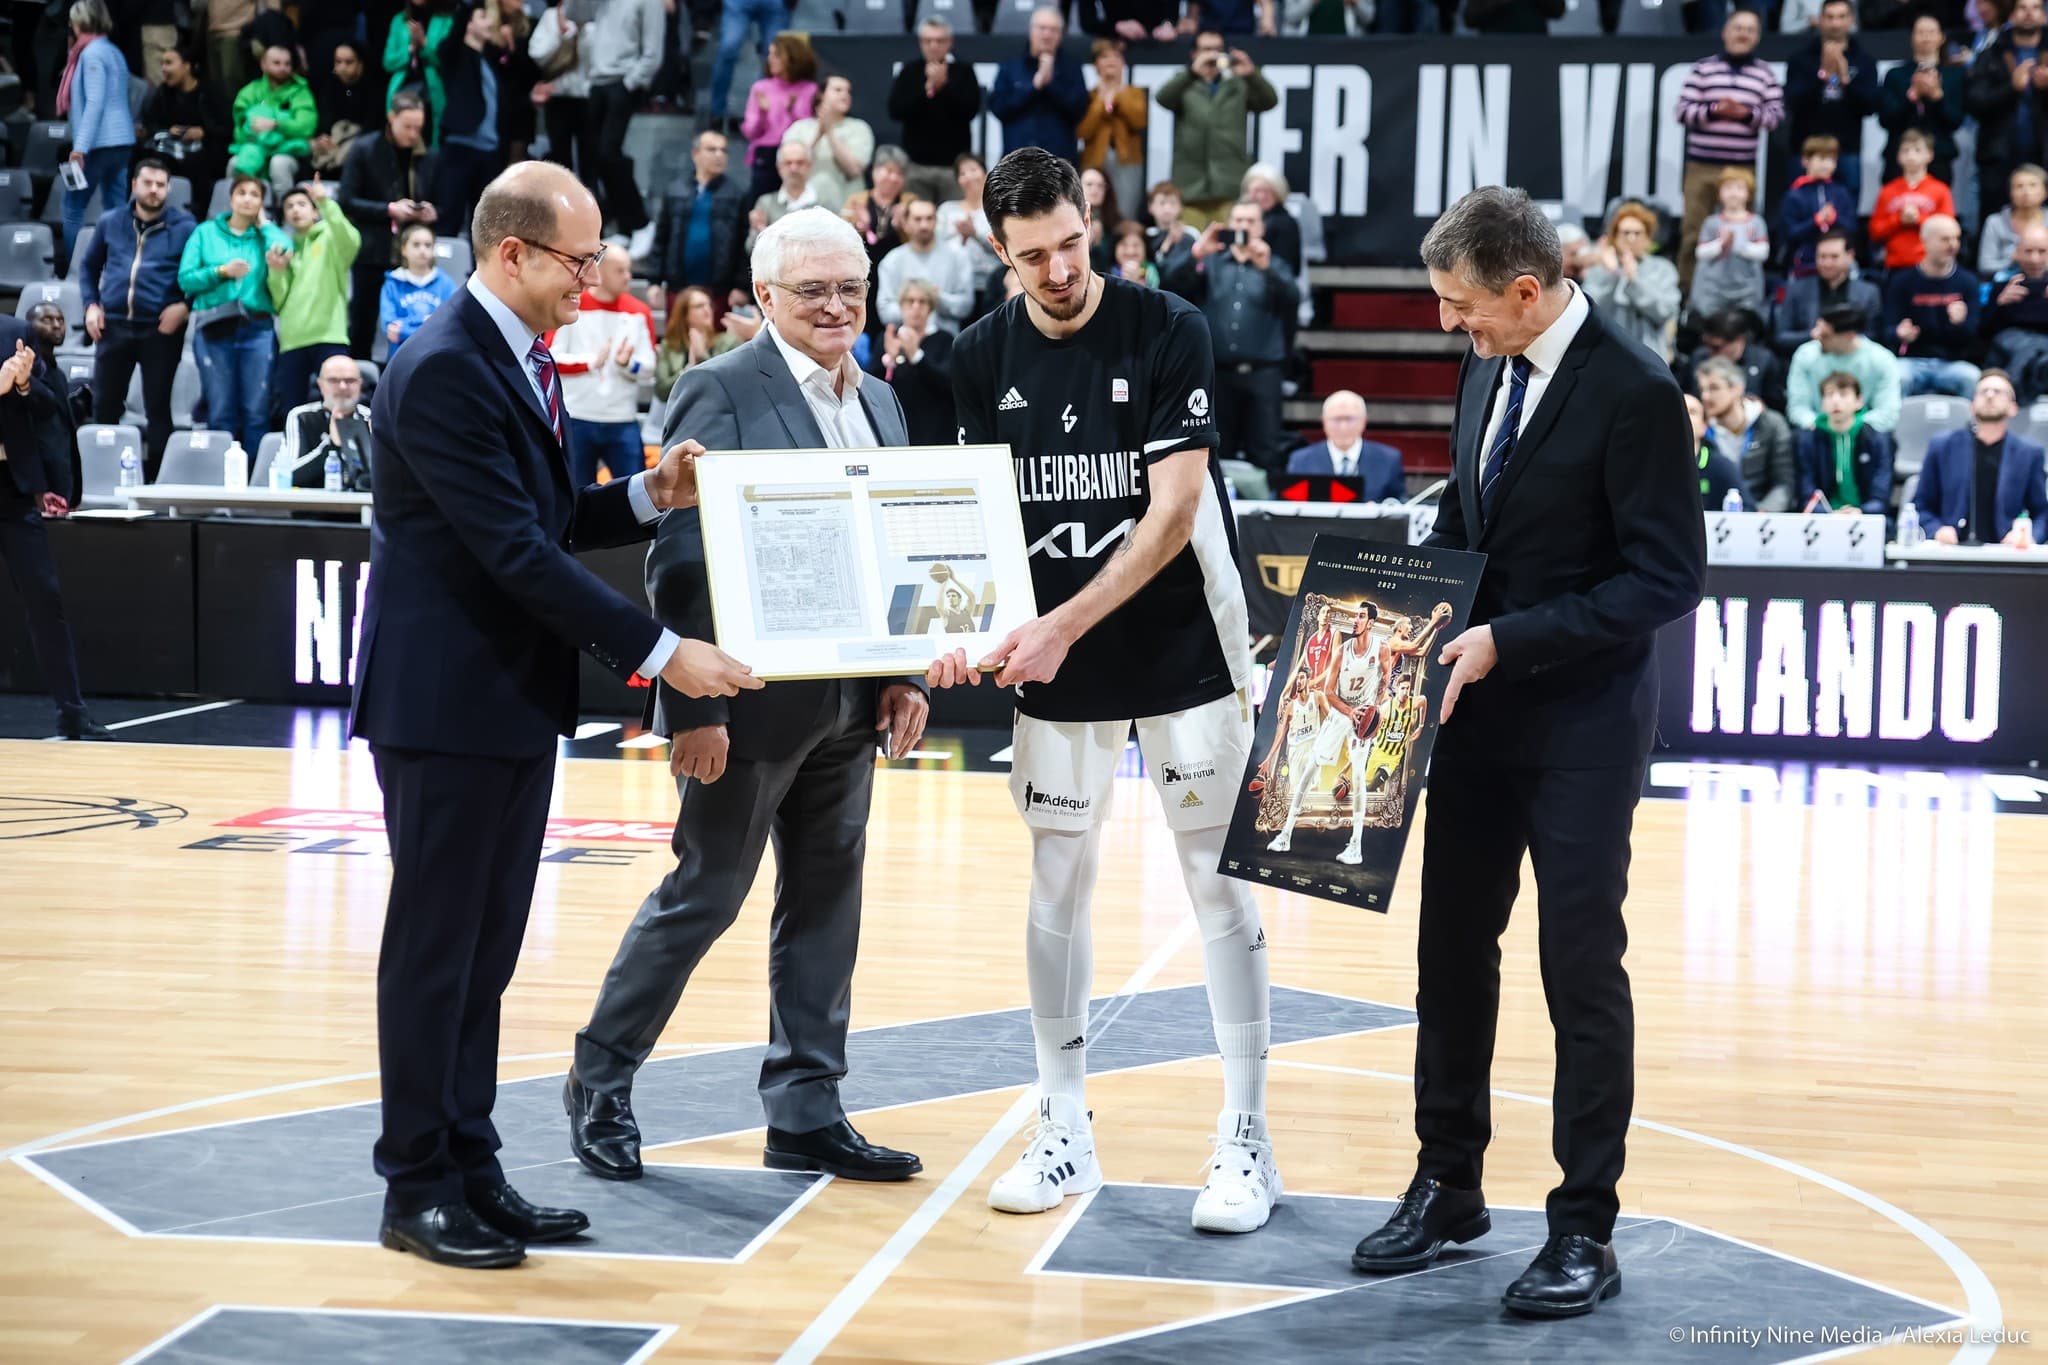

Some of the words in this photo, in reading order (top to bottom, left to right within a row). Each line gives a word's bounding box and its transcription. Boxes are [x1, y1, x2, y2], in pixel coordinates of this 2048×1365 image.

[1413, 63, 1512, 217] IN
[998, 399, 1028, 411] adidas
[1357, 551, 1387, 564] NANDO
[1391, 556, 1404, 566] DE
[1408, 558, 1432, 569] COLO
[1377, 581, 1397, 590] 2023
[1689, 597, 2002, 742] NANDO
[1349, 677, 1365, 691] 12
[1179, 758, 1214, 773] Entreprise
[1182, 772, 1192, 781] DU
[1193, 769, 1216, 780] FUTUR
[1042, 793, 1091, 811] Adéqua
[1180, 800, 1203, 809] adidas
